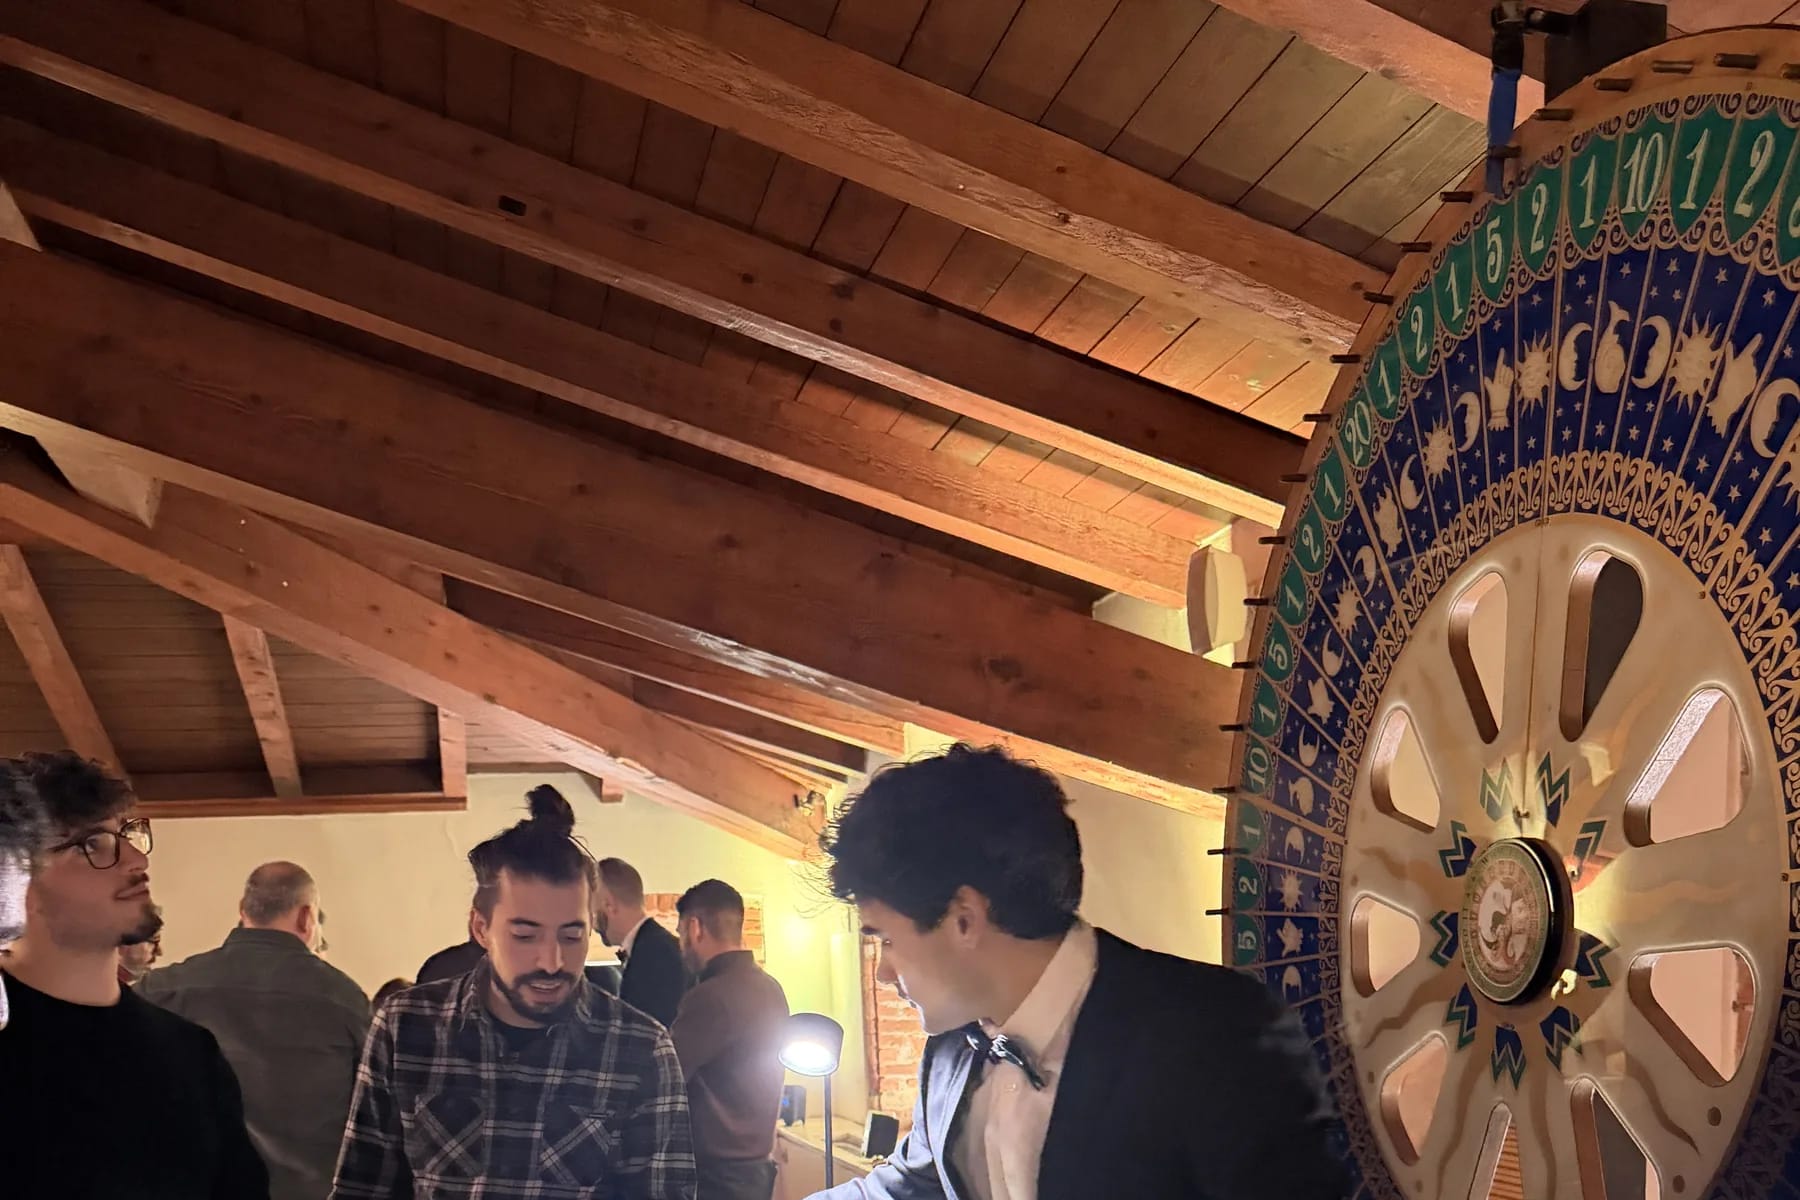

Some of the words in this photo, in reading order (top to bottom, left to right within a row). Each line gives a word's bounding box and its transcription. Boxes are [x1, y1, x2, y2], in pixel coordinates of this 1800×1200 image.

[1579, 155, 1597, 229] 1
[1620, 131, 1665, 215] 10
[1679, 128, 1711, 210] 1
[1733, 130, 1775, 218] 2
[1530, 182, 1547, 254] 2
[1486, 216, 1503, 284] 5
[1446, 264, 1464, 322] 1
[1410, 304, 1428, 362] 2
[1376, 360, 1395, 406] 1
[1345, 402, 1372, 462] 20
[1323, 472, 1340, 513] 1
[1302, 526, 1321, 566] 2
[1285, 585, 1302, 615] 1
[1268, 638, 1288, 670] 5
[1258, 702, 1278, 726] 1
[1247, 747, 1269, 791] 10
[1242, 824, 1262, 839] 1
[1238, 875, 1258, 895] 2
[1237, 930, 1257, 951] 5
